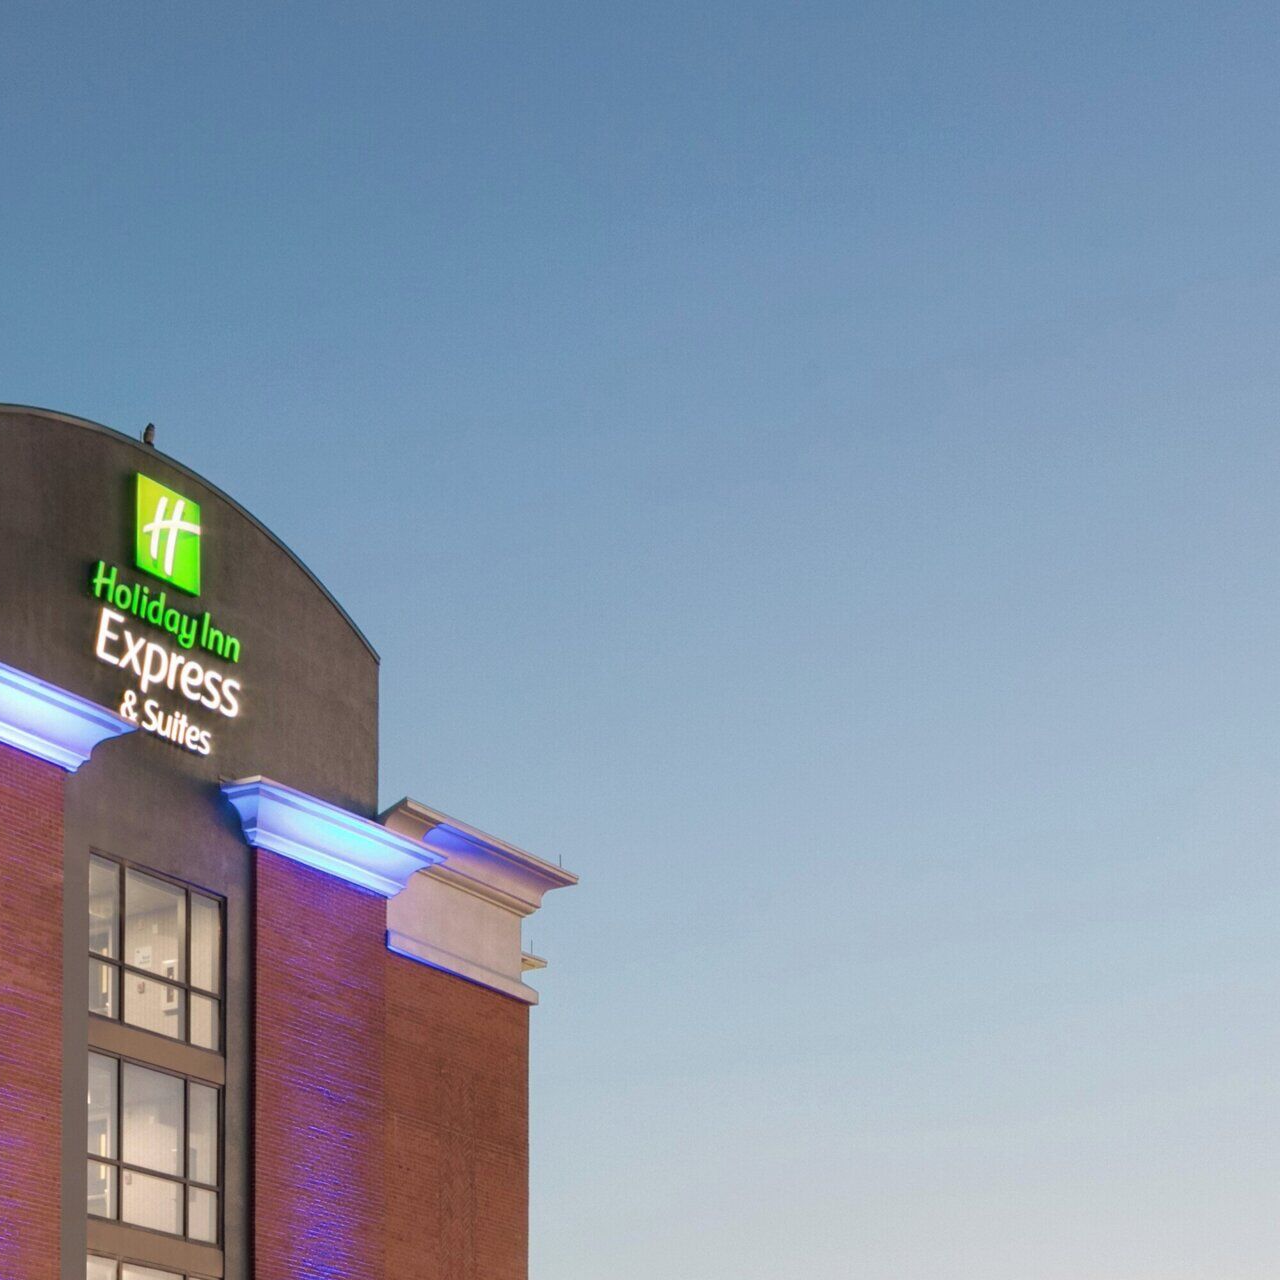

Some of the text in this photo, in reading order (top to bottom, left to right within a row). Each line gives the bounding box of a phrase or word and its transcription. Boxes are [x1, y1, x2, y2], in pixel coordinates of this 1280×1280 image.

[93, 560, 240, 663] Holiday Inn
[96, 606, 241, 718] Express
[120, 689, 212, 756] & Suites
